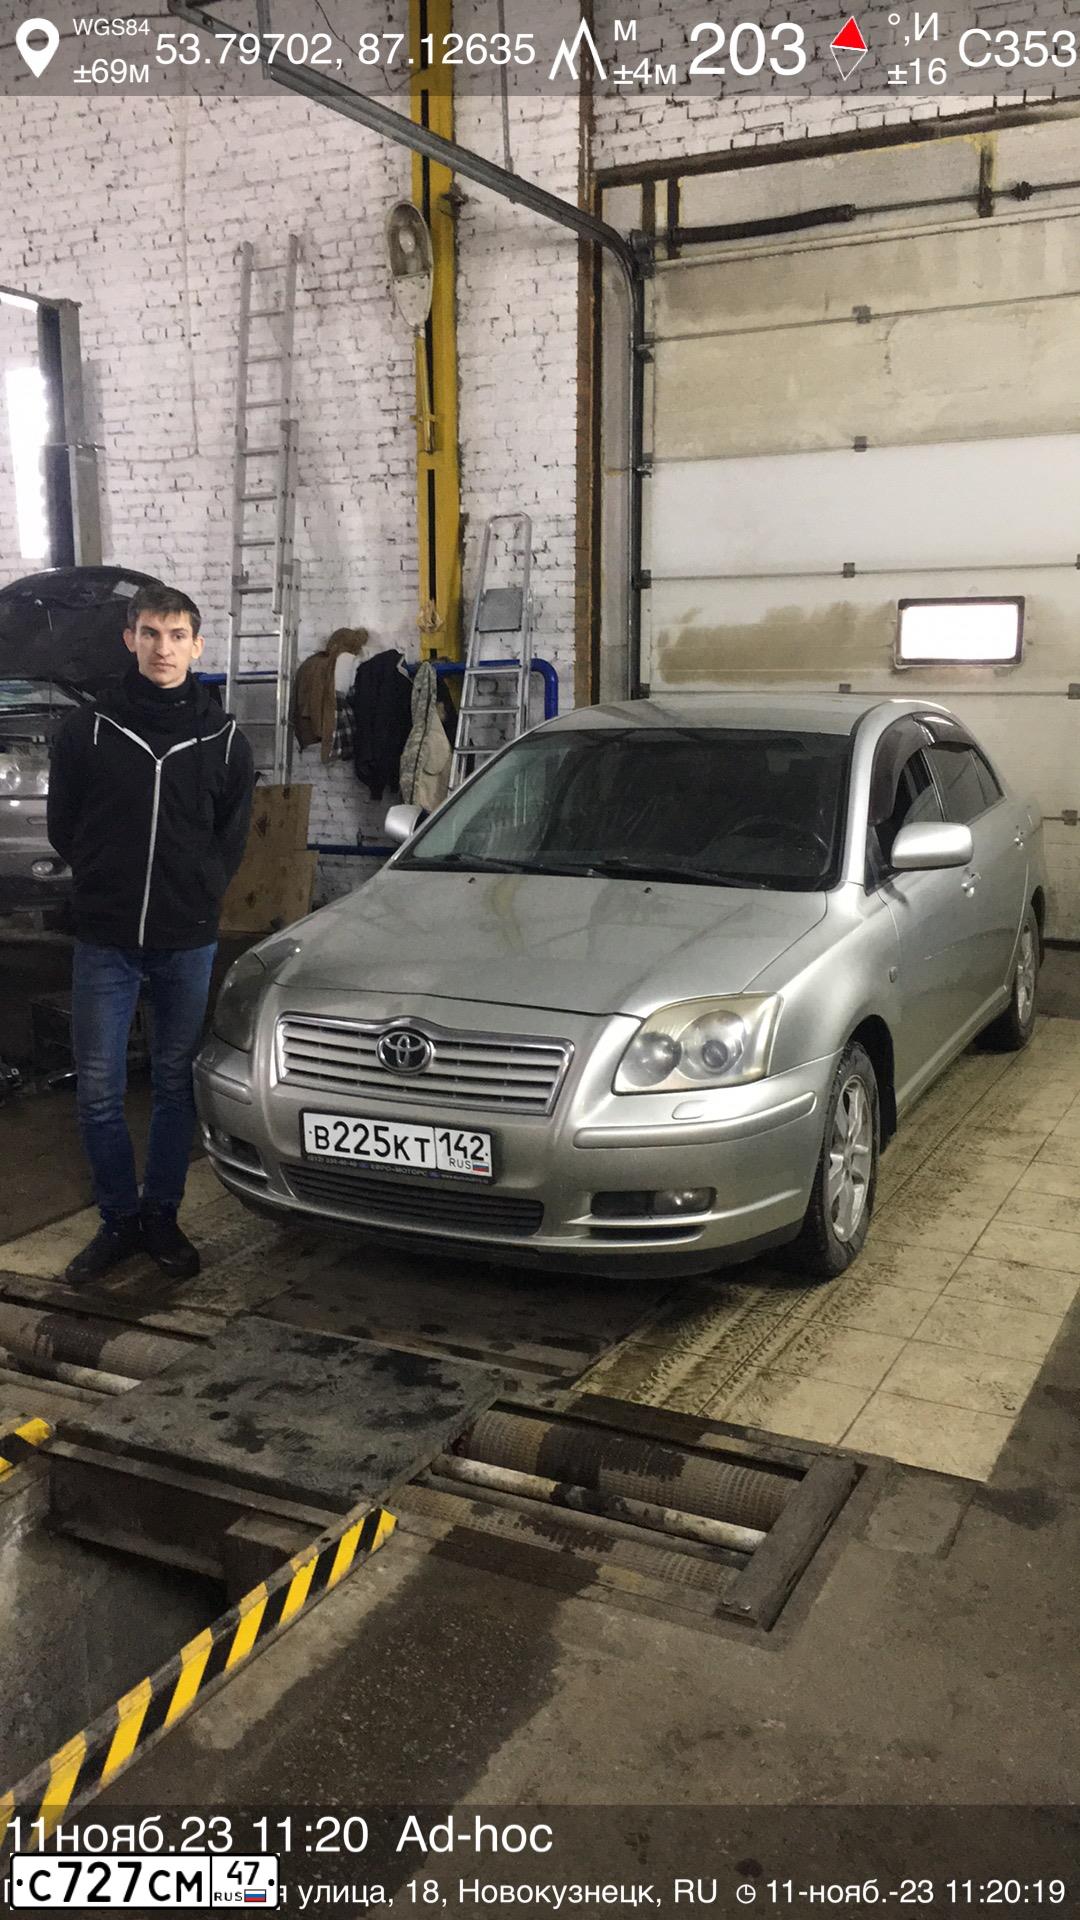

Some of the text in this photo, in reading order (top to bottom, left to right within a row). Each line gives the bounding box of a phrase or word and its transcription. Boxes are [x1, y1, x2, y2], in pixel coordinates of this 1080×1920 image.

[313, 1120, 485, 1163] В225КТ 142
[450, 1157, 472, 1170] RUS
